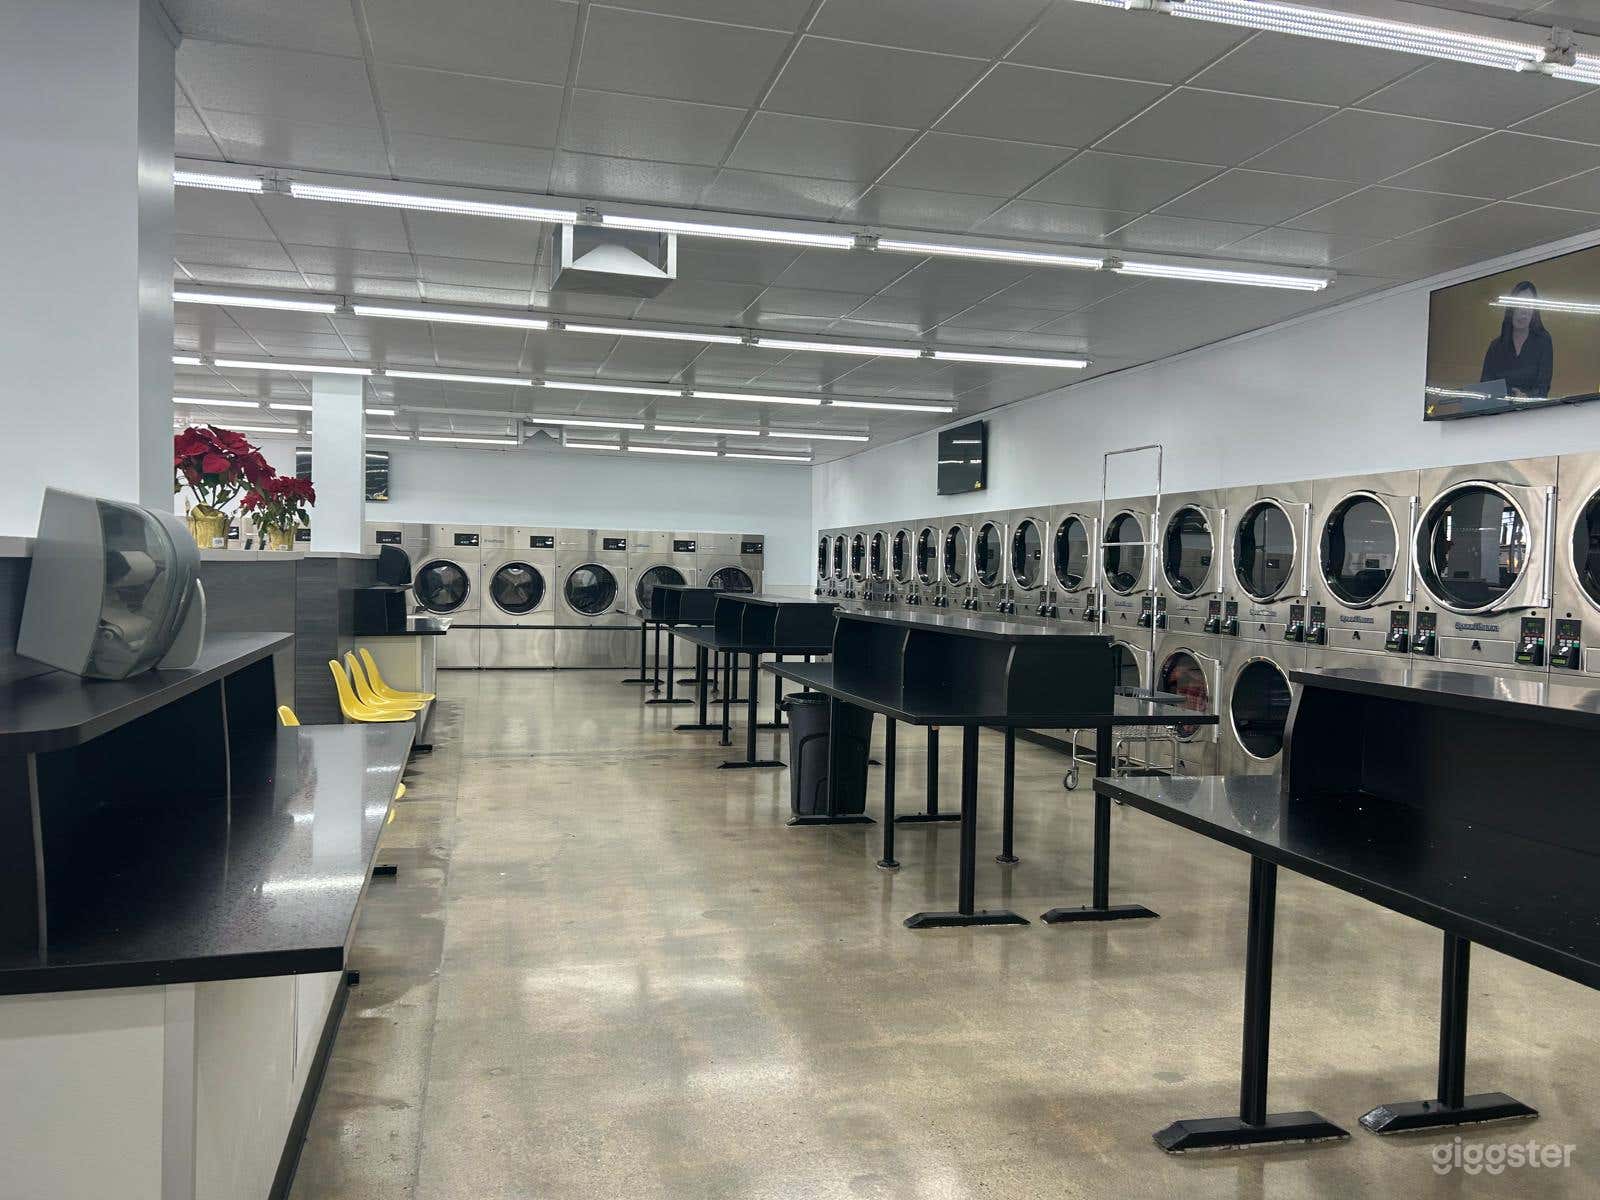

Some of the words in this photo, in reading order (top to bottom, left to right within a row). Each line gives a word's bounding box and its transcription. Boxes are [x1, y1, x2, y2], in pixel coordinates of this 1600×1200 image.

[1258, 623, 1267, 633] A
[1352, 631, 1360, 640] A
[1472, 640, 1481, 651] A
